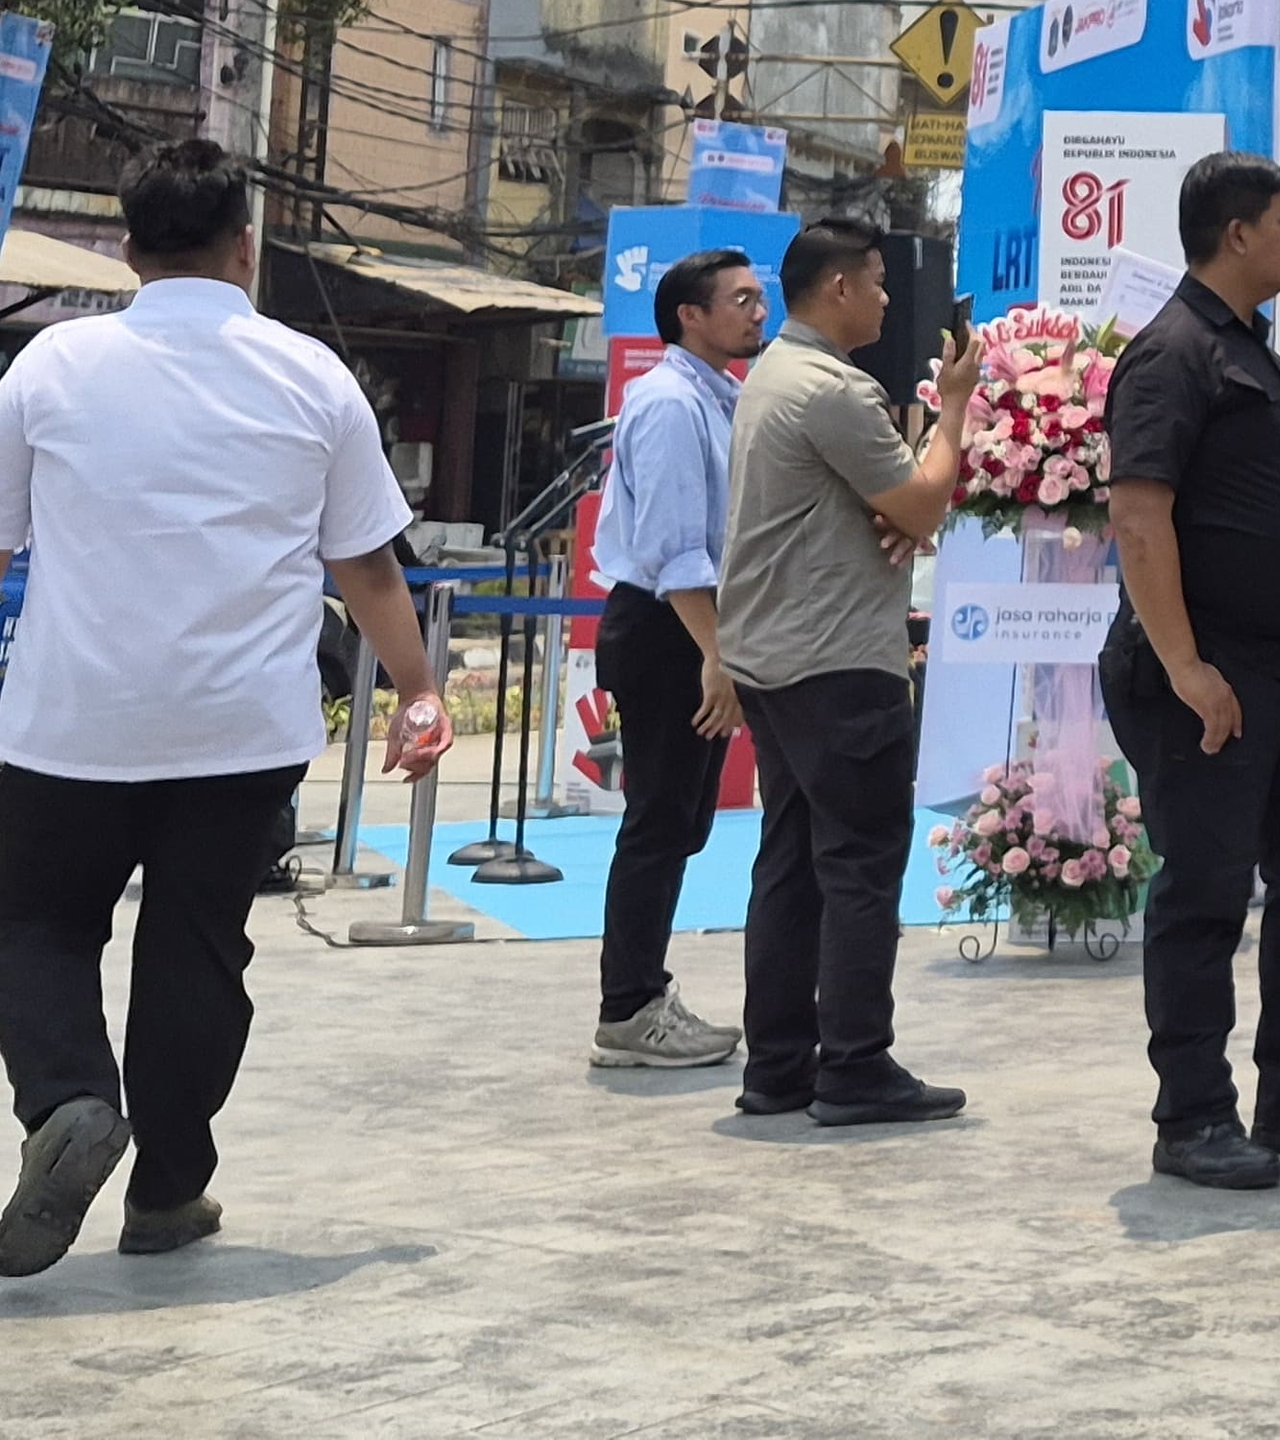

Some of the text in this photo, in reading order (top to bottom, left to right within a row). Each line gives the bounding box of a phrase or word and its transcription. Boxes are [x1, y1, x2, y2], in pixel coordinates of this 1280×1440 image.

[1063, 135, 1126, 145] DIRGAHAYU
[1063, 148, 1177, 159] REPUBLIK INDONESIA
[1061, 171, 1132, 250] 81
[992, 228, 1039, 292] LRT
[1060, 256, 1112, 266] INDONESI
[1060, 283, 1102, 293] ADIL DA
[994, 607, 1033, 626] jasa
[1037, 606, 1101, 627] raharja
[994, 629, 1083, 641] insurance
